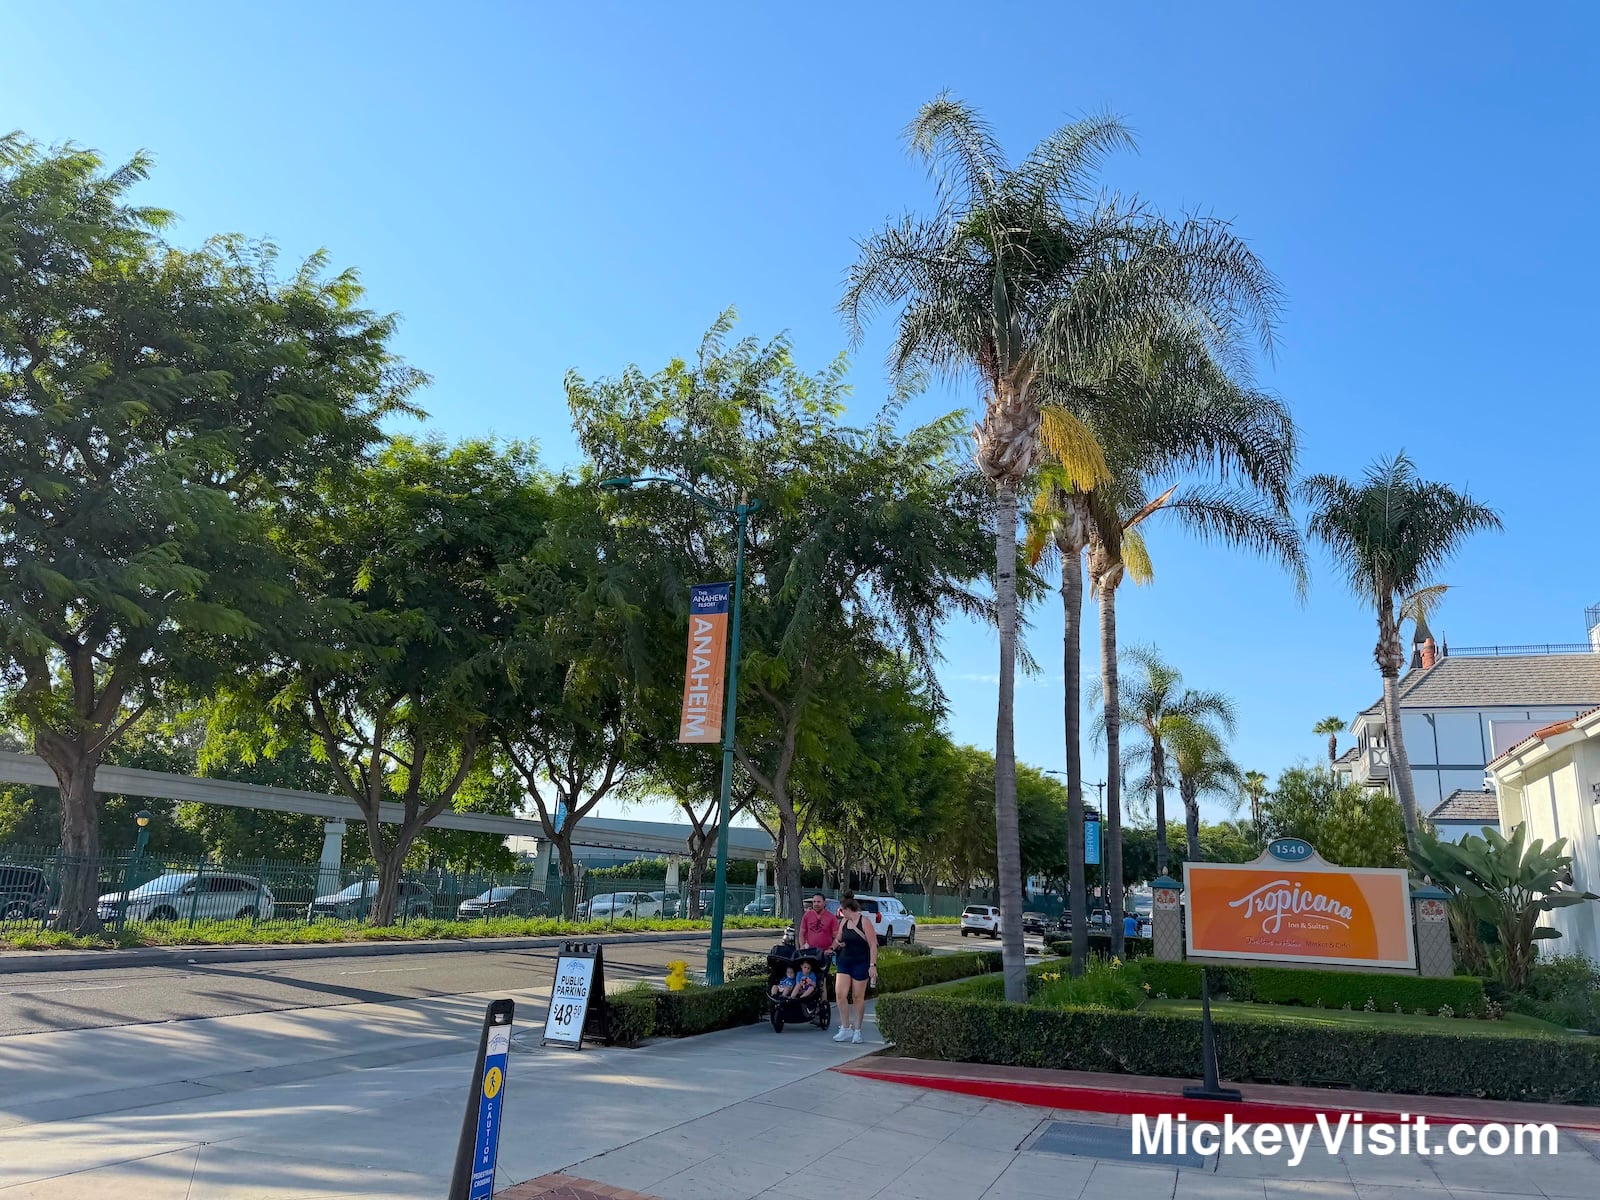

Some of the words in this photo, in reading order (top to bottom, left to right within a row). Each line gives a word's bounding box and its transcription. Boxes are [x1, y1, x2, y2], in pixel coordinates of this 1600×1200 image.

[692, 594, 728, 603] ANAHEIM
[685, 617, 713, 737] ANAHEIM
[1275, 844, 1305, 856] 1540
[1229, 879, 1353, 934] Tropicana
[1307, 922, 1329, 930] Suites
[561, 975, 584, 986] PUBLIC
[556, 985, 587, 997] PARKING
[482, 1102, 493, 1164] CAUTION
